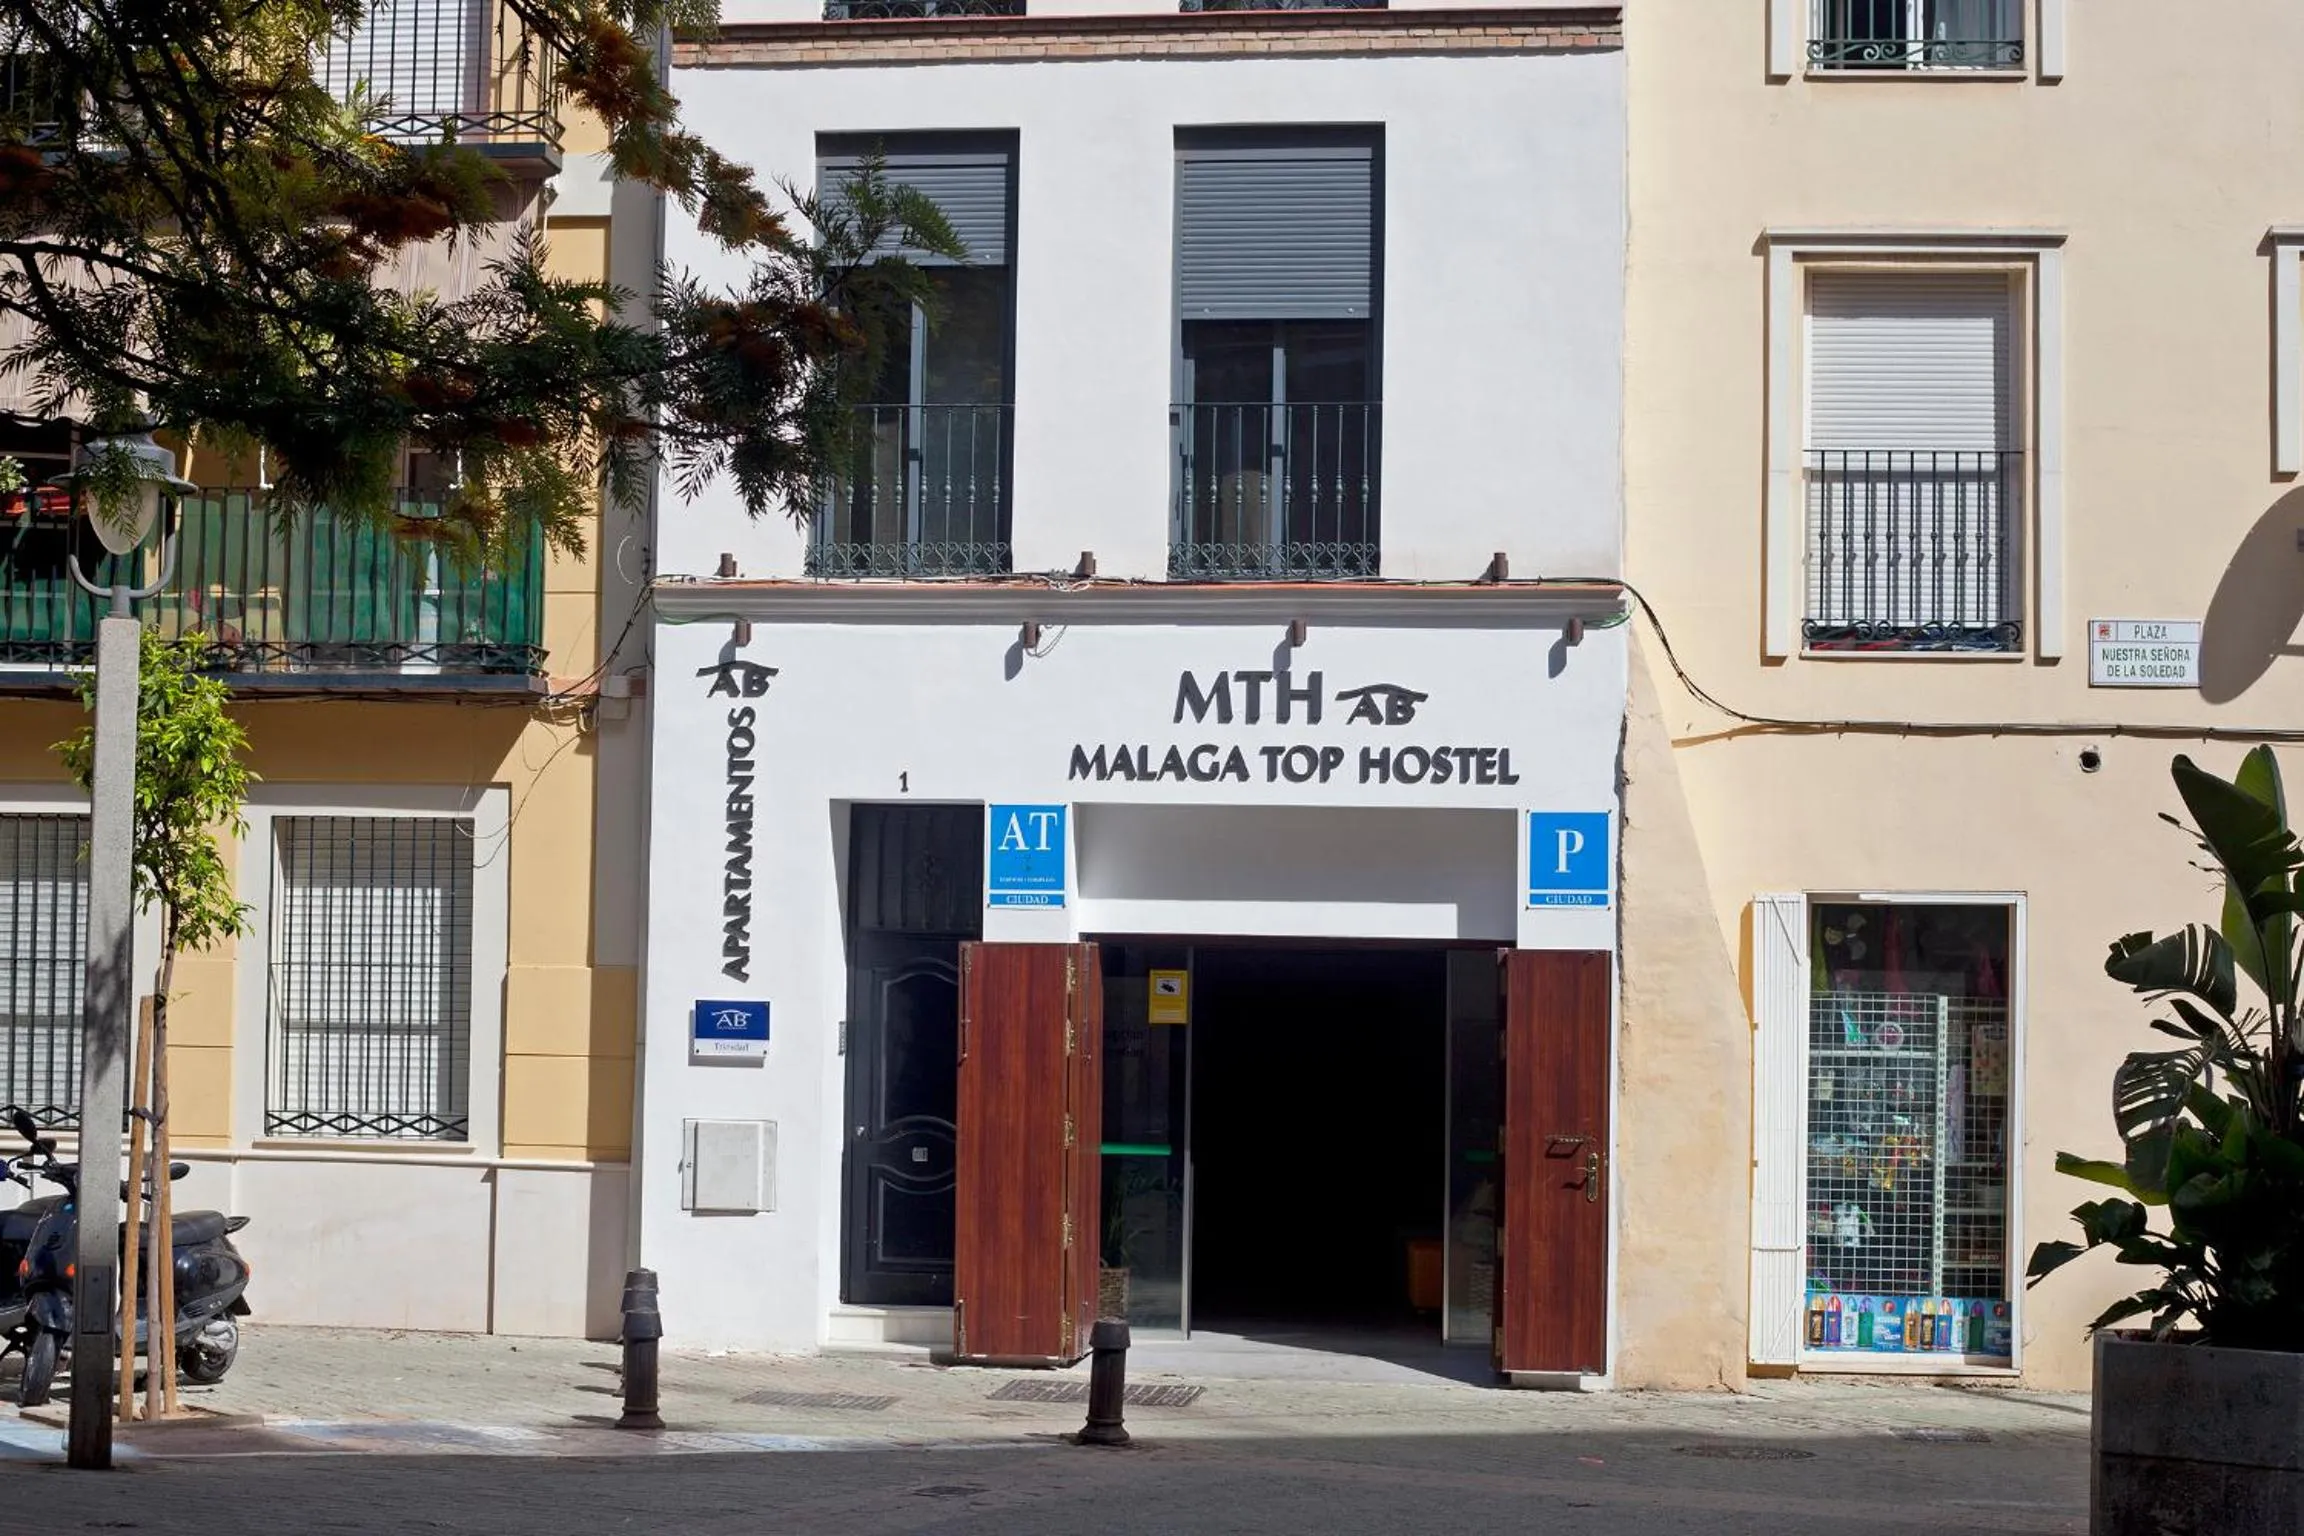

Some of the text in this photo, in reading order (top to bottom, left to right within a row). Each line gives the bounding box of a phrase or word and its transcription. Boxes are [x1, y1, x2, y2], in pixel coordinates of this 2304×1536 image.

[2134, 624, 2168, 640] PLAZA
[2101, 645, 2190, 662] NUESTRA SEÑORA
[703, 663, 773, 699] AB
[2107, 664, 2186, 679] DE LA SOLEDAD
[1173, 670, 1421, 726] MTH AB
[1068, 743, 1520, 786] MALAGA TOP HOSTEL
[899, 770, 909, 793] 1
[997, 810, 1059, 851] AT
[721, 706, 756, 983] APARTAMENTOS
[1554, 828, 1585, 874] P
[1006, 894, 1049, 904] CIUDAD
[1545, 895, 1593, 905] CIUDAD
[713, 1011, 750, 1027] AB
